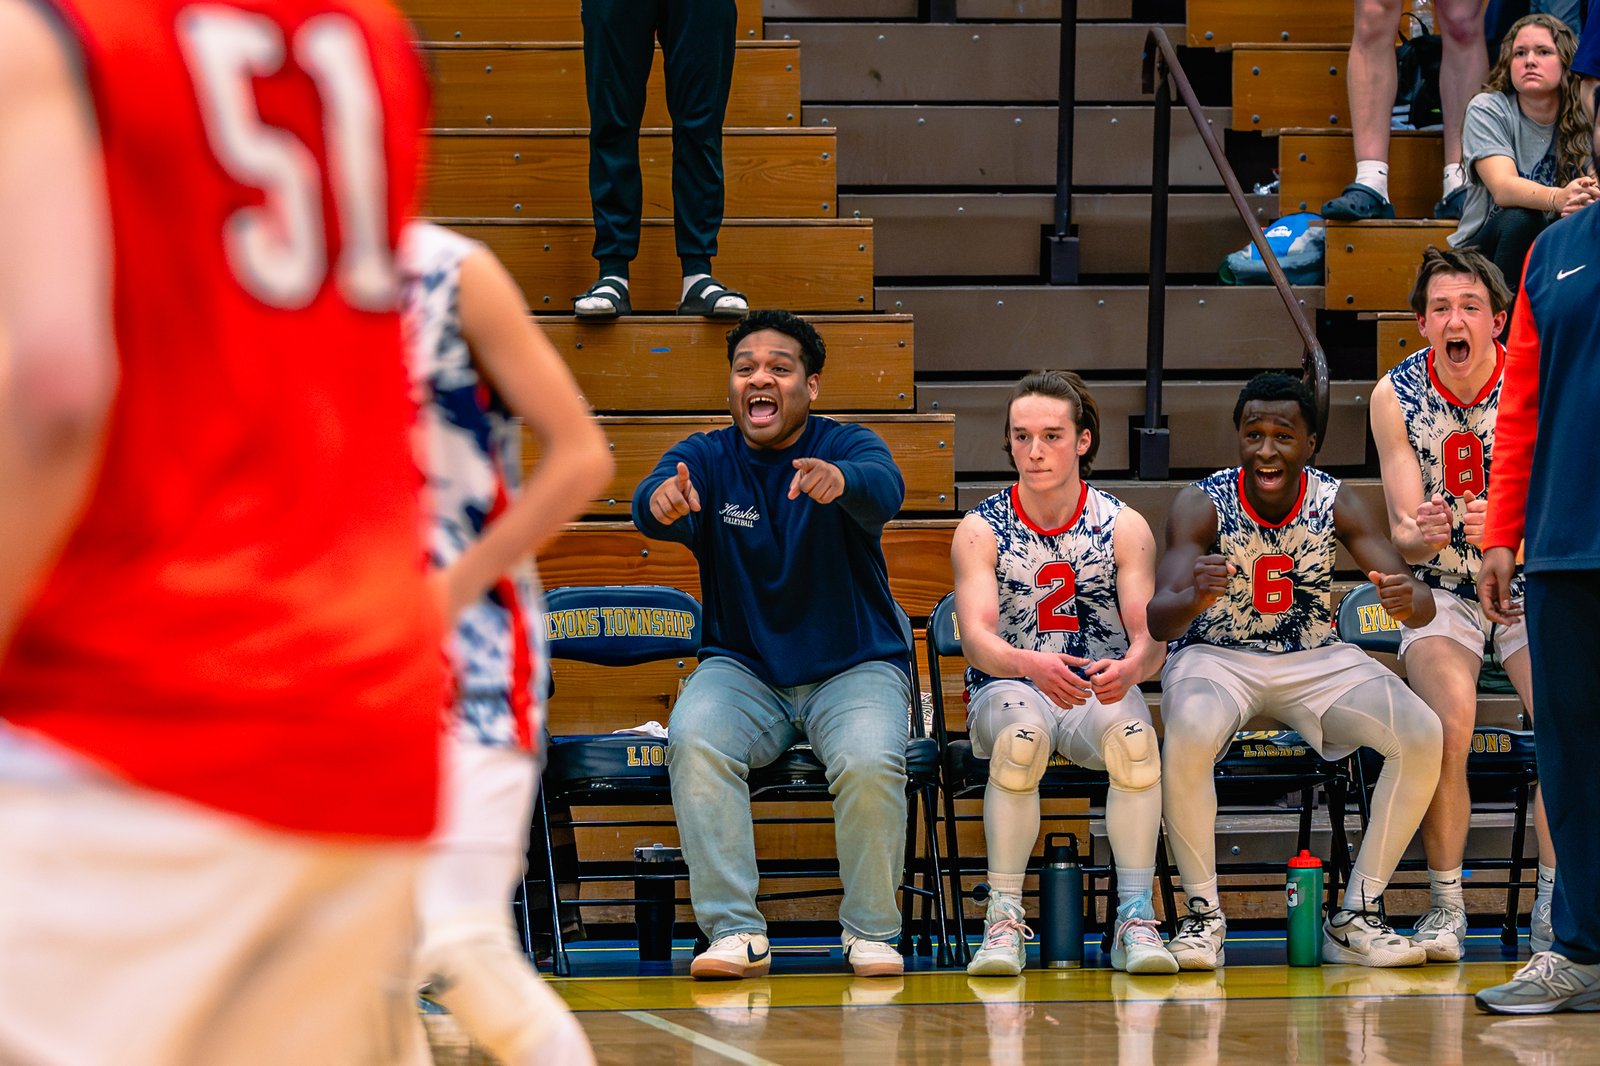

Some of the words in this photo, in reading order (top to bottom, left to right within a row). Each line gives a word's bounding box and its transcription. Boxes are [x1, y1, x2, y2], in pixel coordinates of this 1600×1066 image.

[178, 4, 404, 312] 51
[1441, 430, 1486, 498] 8
[718, 502, 761, 521] Huskie
[723, 515, 754, 528] VOLLEYBALL
[1034, 560, 1079, 633] 2
[1252, 553, 1294, 615] 6
[543, 608, 600, 641] LYONS
[600, 607, 695, 639] TOWNSHIP
[1242, 744, 1306, 757] LIONS
[1470, 733, 1511, 753] ONS
